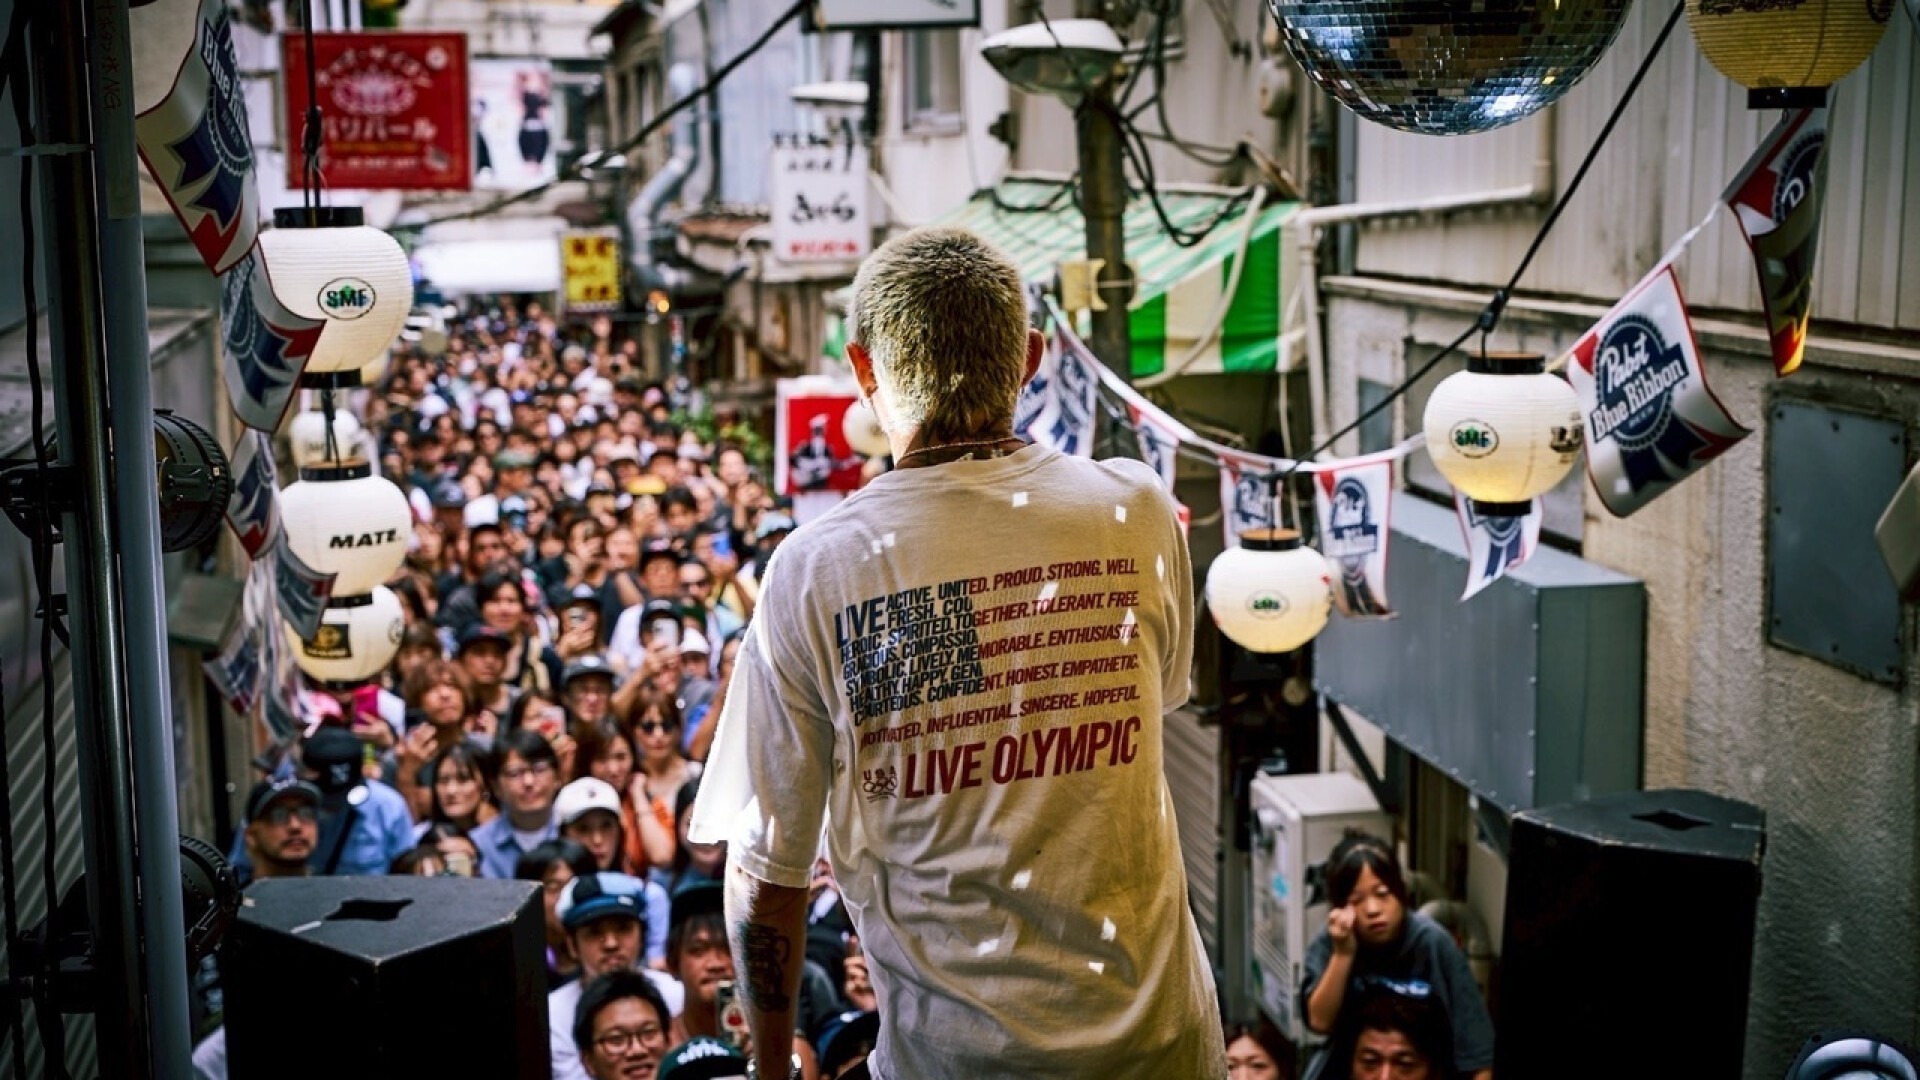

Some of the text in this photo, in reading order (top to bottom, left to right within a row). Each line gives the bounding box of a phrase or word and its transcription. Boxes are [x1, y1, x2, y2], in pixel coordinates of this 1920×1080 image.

[325, 286, 371, 309] SMF
[1600, 331, 1649, 393] Pabst
[1592, 401, 1628, 440] Blue
[1623, 359, 1684, 414] Ribbon
[835, 596, 885, 648] LIVE
[886, 586, 934, 612] ACTIVE.
[938, 577, 990, 599] UNITED.
[993, 566, 1045, 591] PROUD.
[1047, 560, 1102, 581] STRONG.
[841, 633, 885, 663] HEROIC.
[888, 617, 953, 645] SPIRITED.
[954, 603, 1030, 630] TOGETHER.
[1032, 592, 1104, 616] TOLERANT.
[888, 603, 937, 629] FRESH.
[843, 647, 899, 680] GRACIOUS.
[846, 662, 907, 696] SYMBOLIC.
[909, 650, 954, 675] LIVELY.
[957, 633, 1045, 663] MEMORABLE.
[1048, 623, 1140, 647] ENTHUSIASTIC.
[927, 672, 1003, 702] CONFIDENT.
[1006, 663, 1059, 687] HONEST.
[1061, 654, 1139, 678] EMPATHETIC.
[850, 680, 900, 712] HEALTHY.
[903, 668, 948, 693] HAPPY.
[927, 703, 1017, 733] INFLUENTIAL.
[1020, 693, 1080, 717] SINCERE.
[906, 742, 985, 798] LIVE
[992, 716, 1141, 784] OLYMPIC
